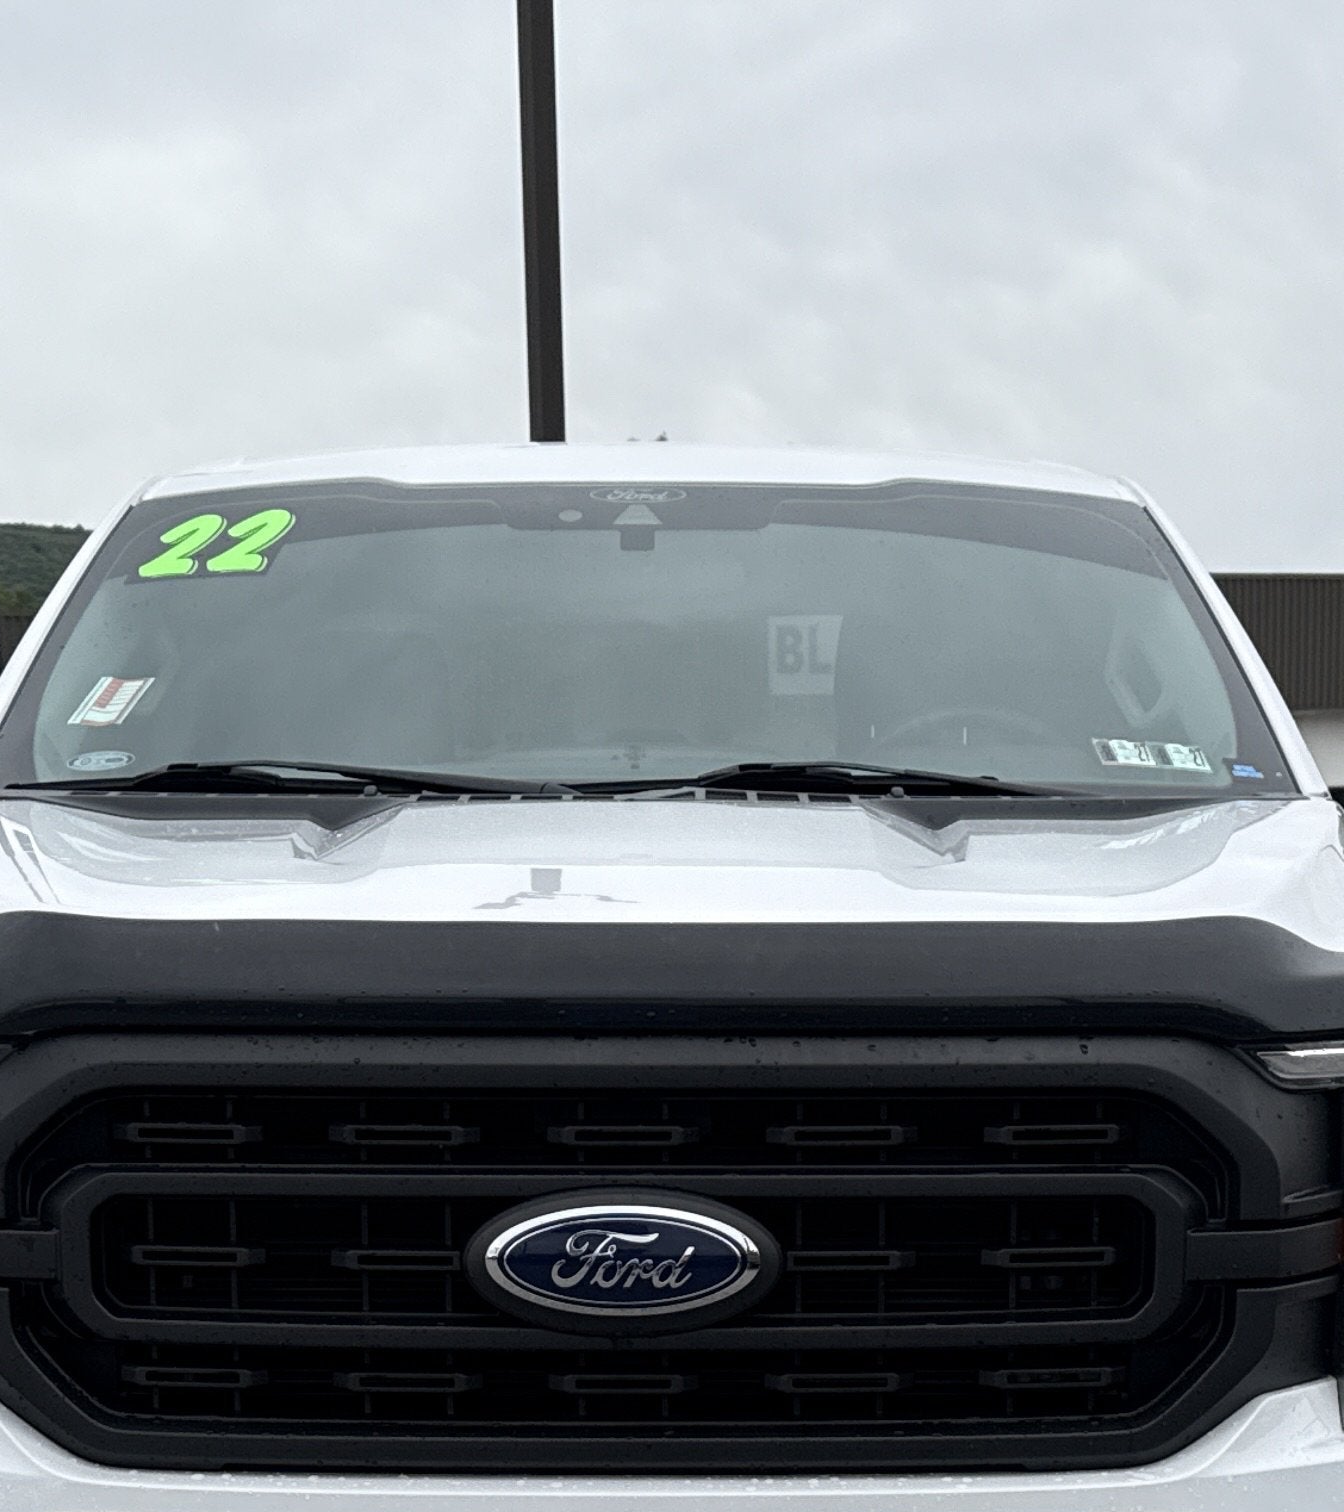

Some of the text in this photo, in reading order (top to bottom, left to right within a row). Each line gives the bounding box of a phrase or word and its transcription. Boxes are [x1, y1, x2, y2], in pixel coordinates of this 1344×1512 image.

[607, 488, 669, 501] Ford
[138, 509, 296, 577] 22
[551, 1229, 696, 1288] Ford
